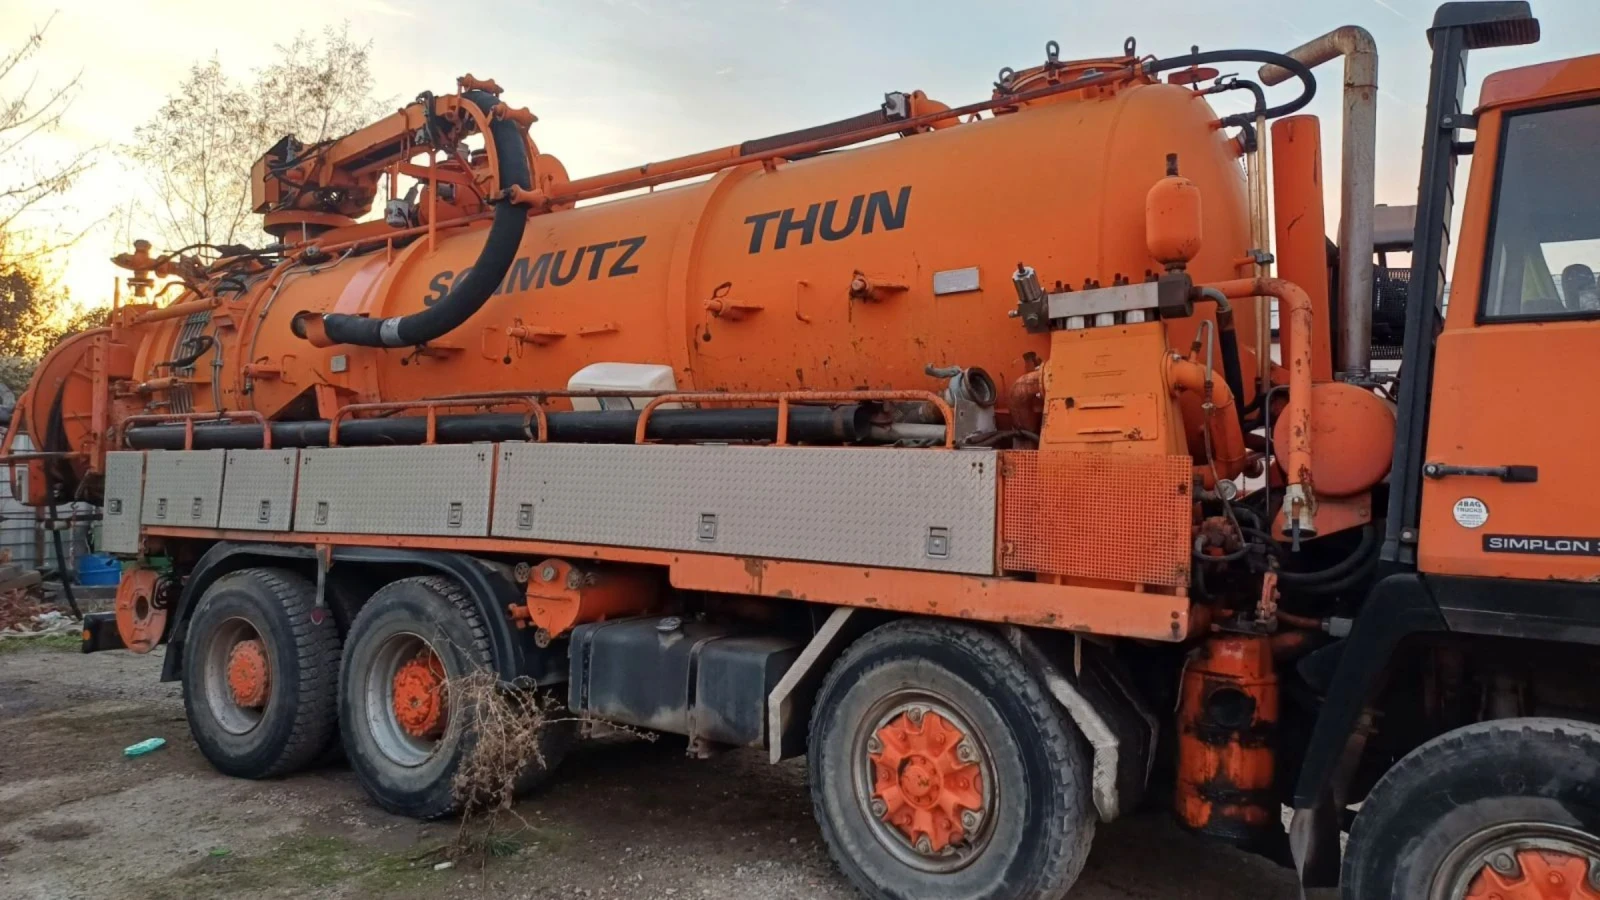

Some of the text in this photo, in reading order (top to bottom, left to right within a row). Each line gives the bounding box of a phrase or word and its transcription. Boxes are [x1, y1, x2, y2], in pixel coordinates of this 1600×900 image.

[424, 185, 912, 307] SMUTZ THUN
[1489, 537, 1589, 552] SIMPLON
